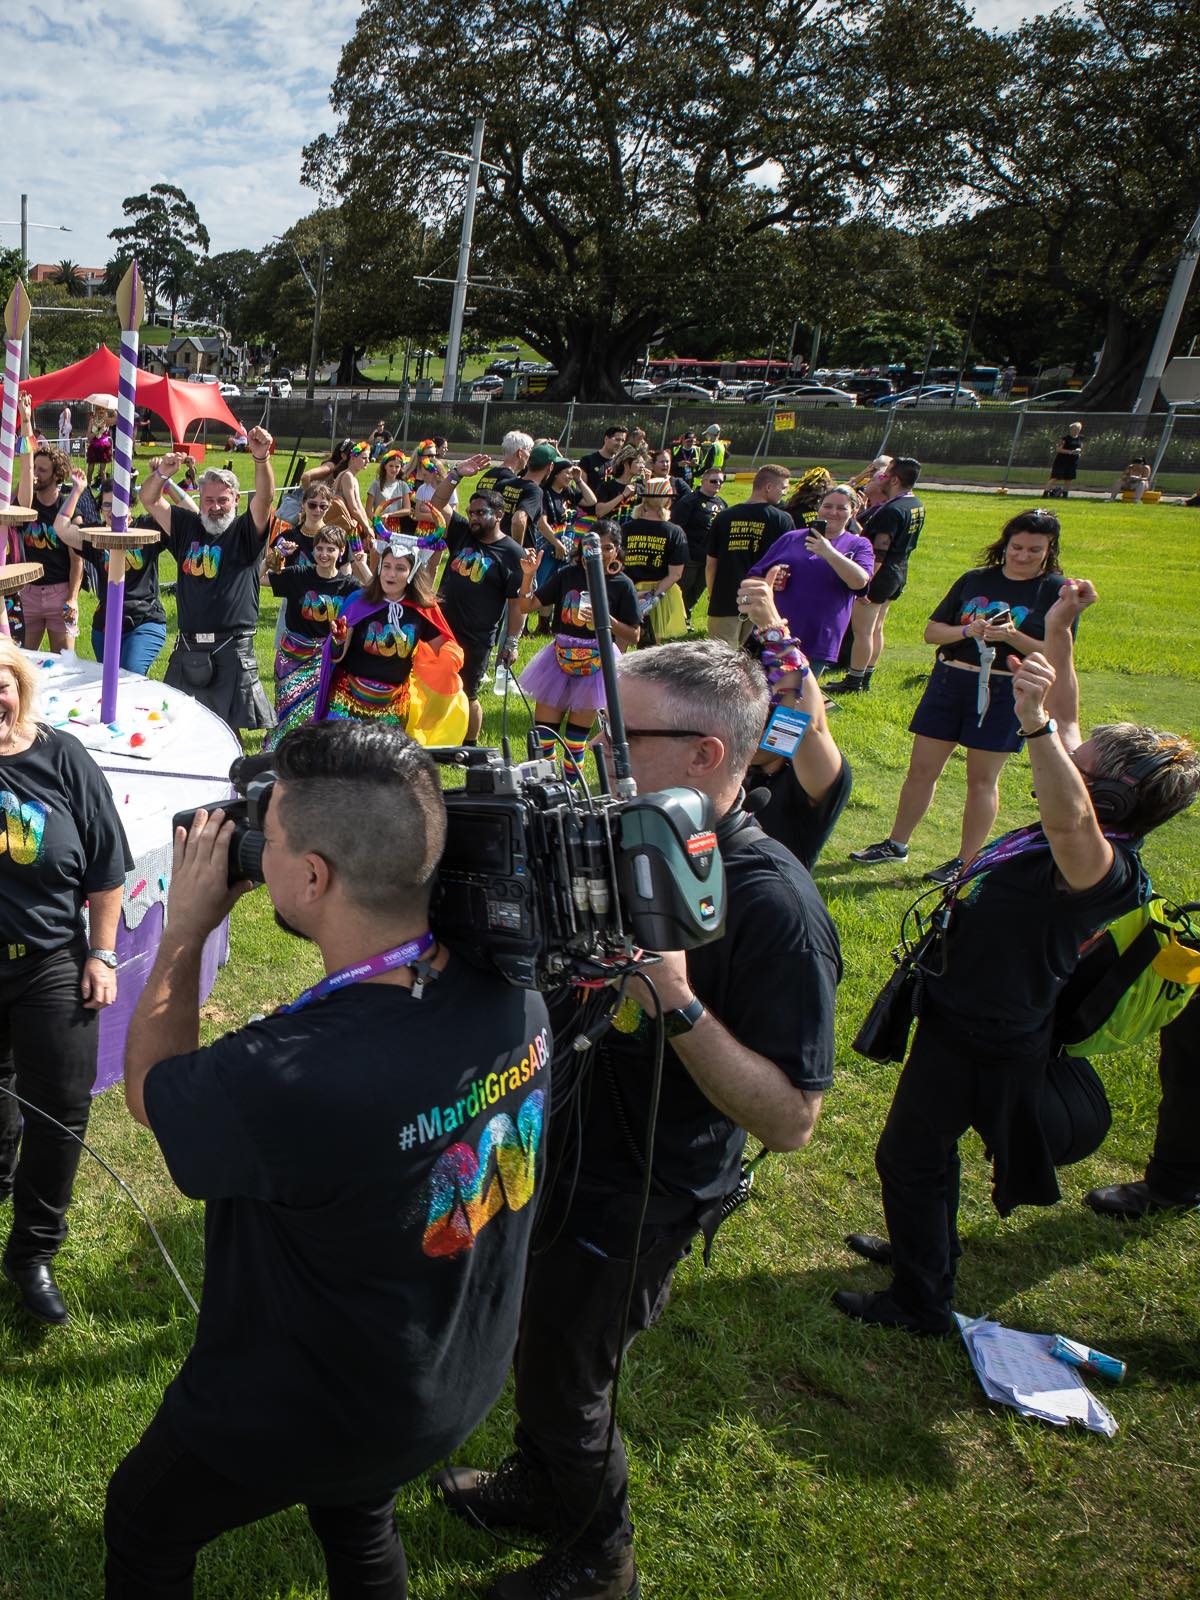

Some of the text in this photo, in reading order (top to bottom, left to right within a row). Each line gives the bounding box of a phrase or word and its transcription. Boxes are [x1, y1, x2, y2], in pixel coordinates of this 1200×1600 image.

[647, 536, 667, 544] RIGHTS
[648, 543, 665, 551] PRIDE
[342, 971, 351, 979] we
[352, 964, 372, 978] united
[399, 1027, 550, 1151] #MardiGrasABC
